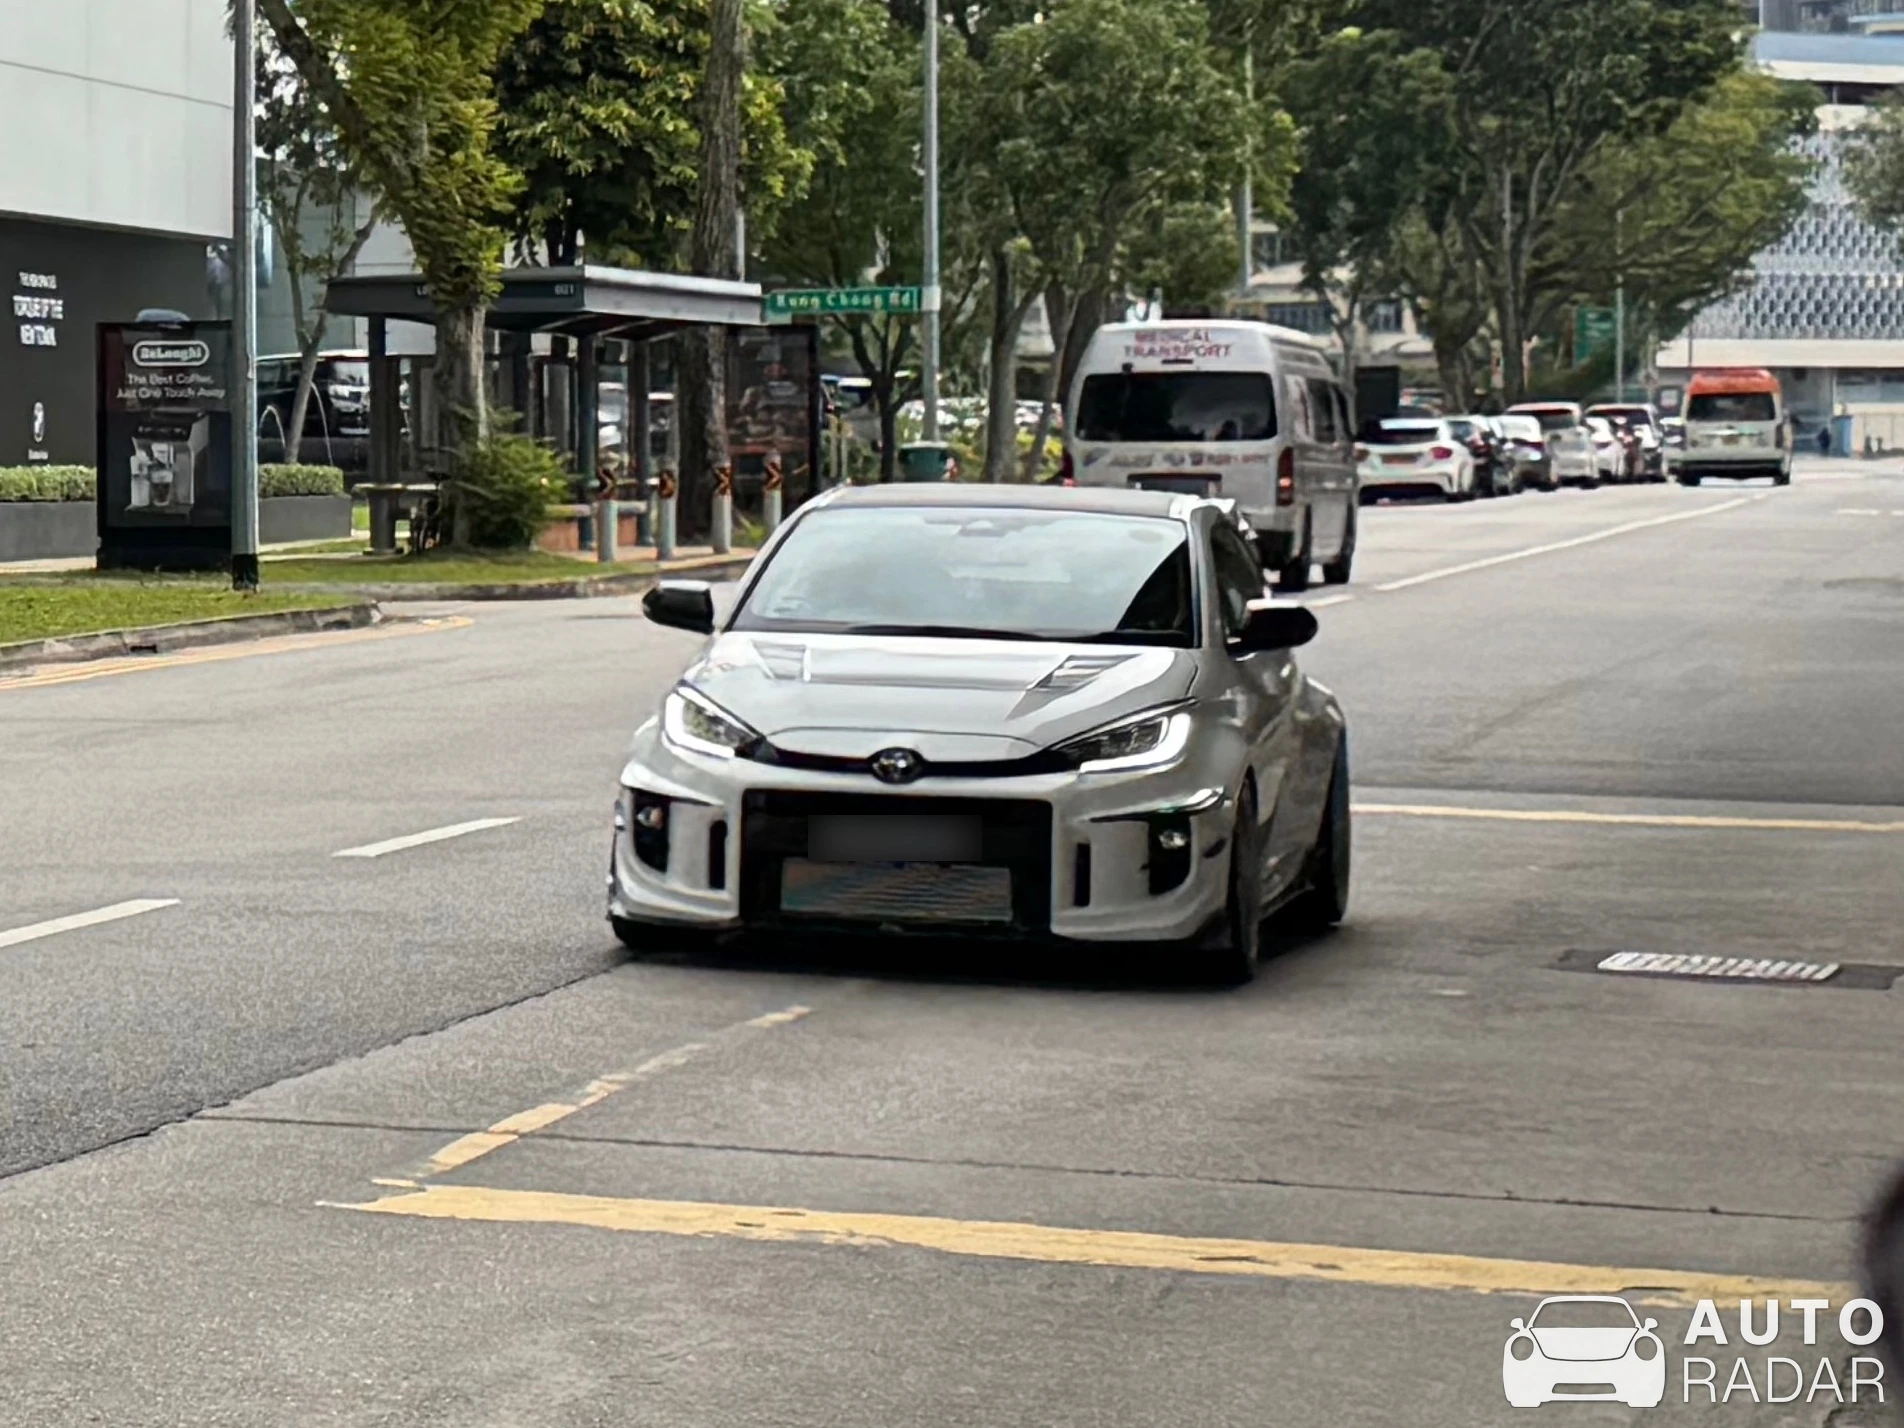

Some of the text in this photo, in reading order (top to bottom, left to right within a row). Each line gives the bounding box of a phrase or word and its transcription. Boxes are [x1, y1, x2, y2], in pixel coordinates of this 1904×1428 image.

[1134, 329, 1210, 342] MEDICAL
[1124, 344, 1232, 358] TRANSPORT
[128, 373, 147, 385] The
[138, 387, 161, 399] One
[163, 387, 195, 398] Touch
